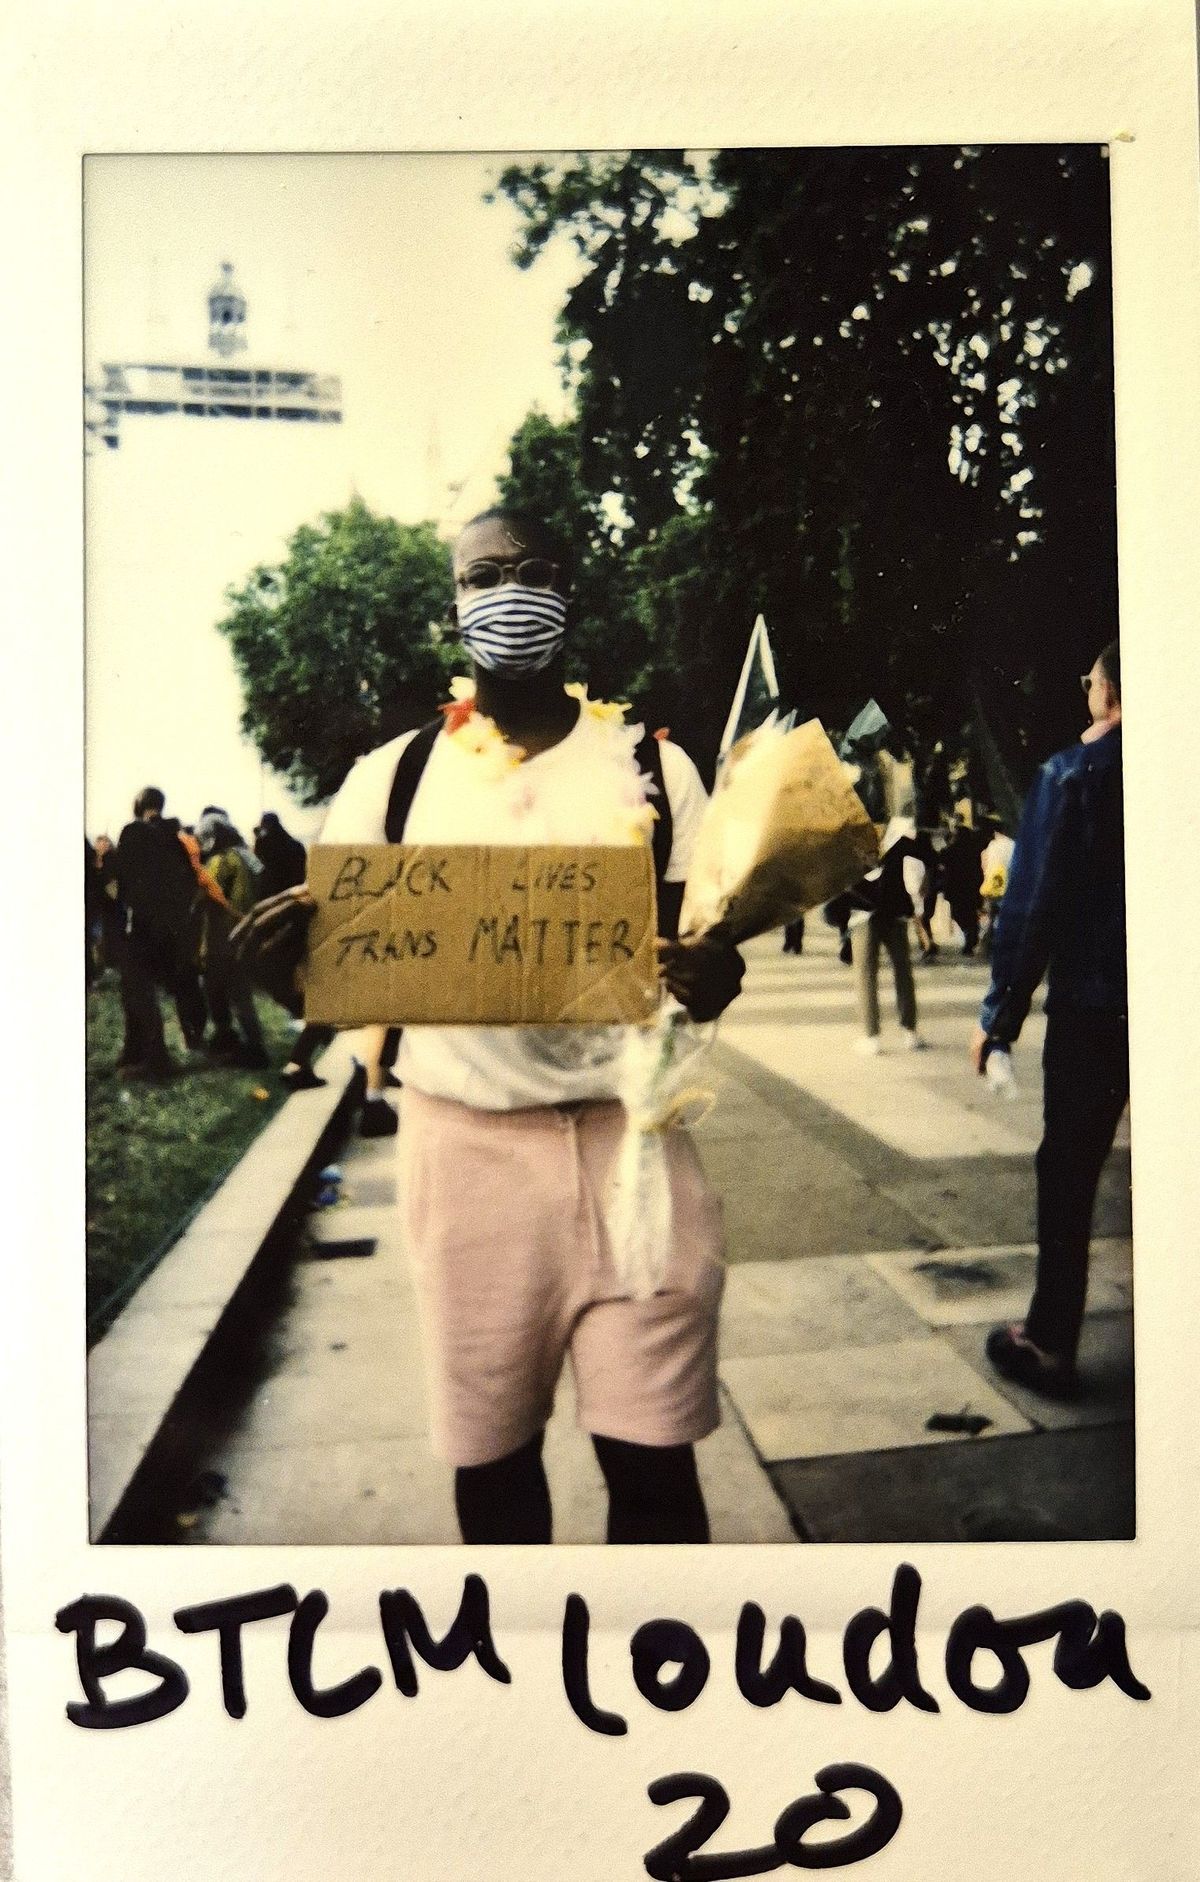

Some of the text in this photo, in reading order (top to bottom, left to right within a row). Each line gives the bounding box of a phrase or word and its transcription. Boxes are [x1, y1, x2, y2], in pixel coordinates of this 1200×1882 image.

[512, 862, 597, 892] LIVES
[335, 914, 635, 966] TRANS MATTER
[643, 1763, 903, 1882] 20
